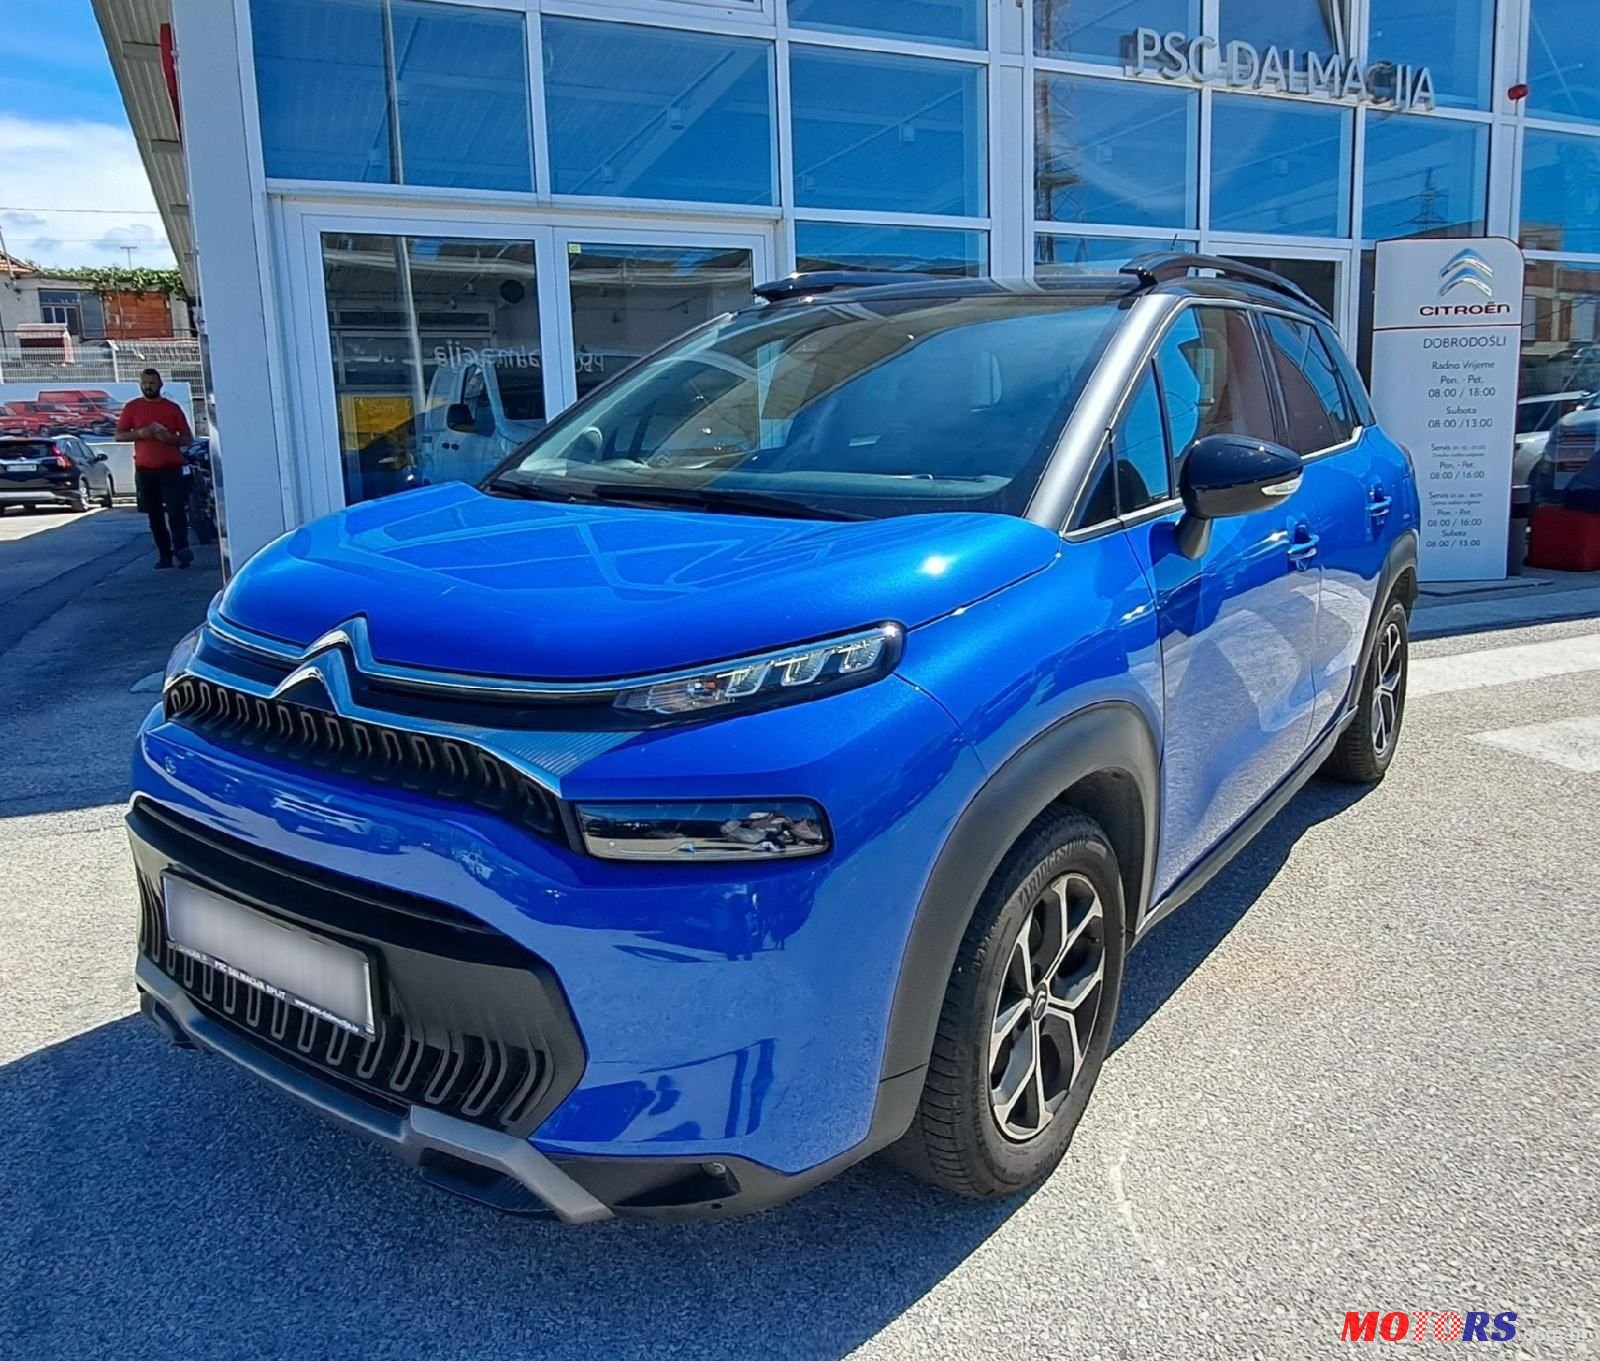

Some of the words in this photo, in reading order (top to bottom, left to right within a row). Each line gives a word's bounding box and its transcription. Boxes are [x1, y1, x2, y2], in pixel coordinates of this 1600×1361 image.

[1134, 27, 1218, 83] PSC
[1226, 39, 1436, 113] DALMACIJA
[1420, 301, 1511, 317] CITROËN
[1423, 335, 1507, 349] DOBRODOŠLI
[1432, 360, 1460, 370] Radno
[1462, 360, 1495, 371] Vrijeme
[1428, 388, 1457, 398] 08:00
[1446, 405, 1477, 415] Subota
